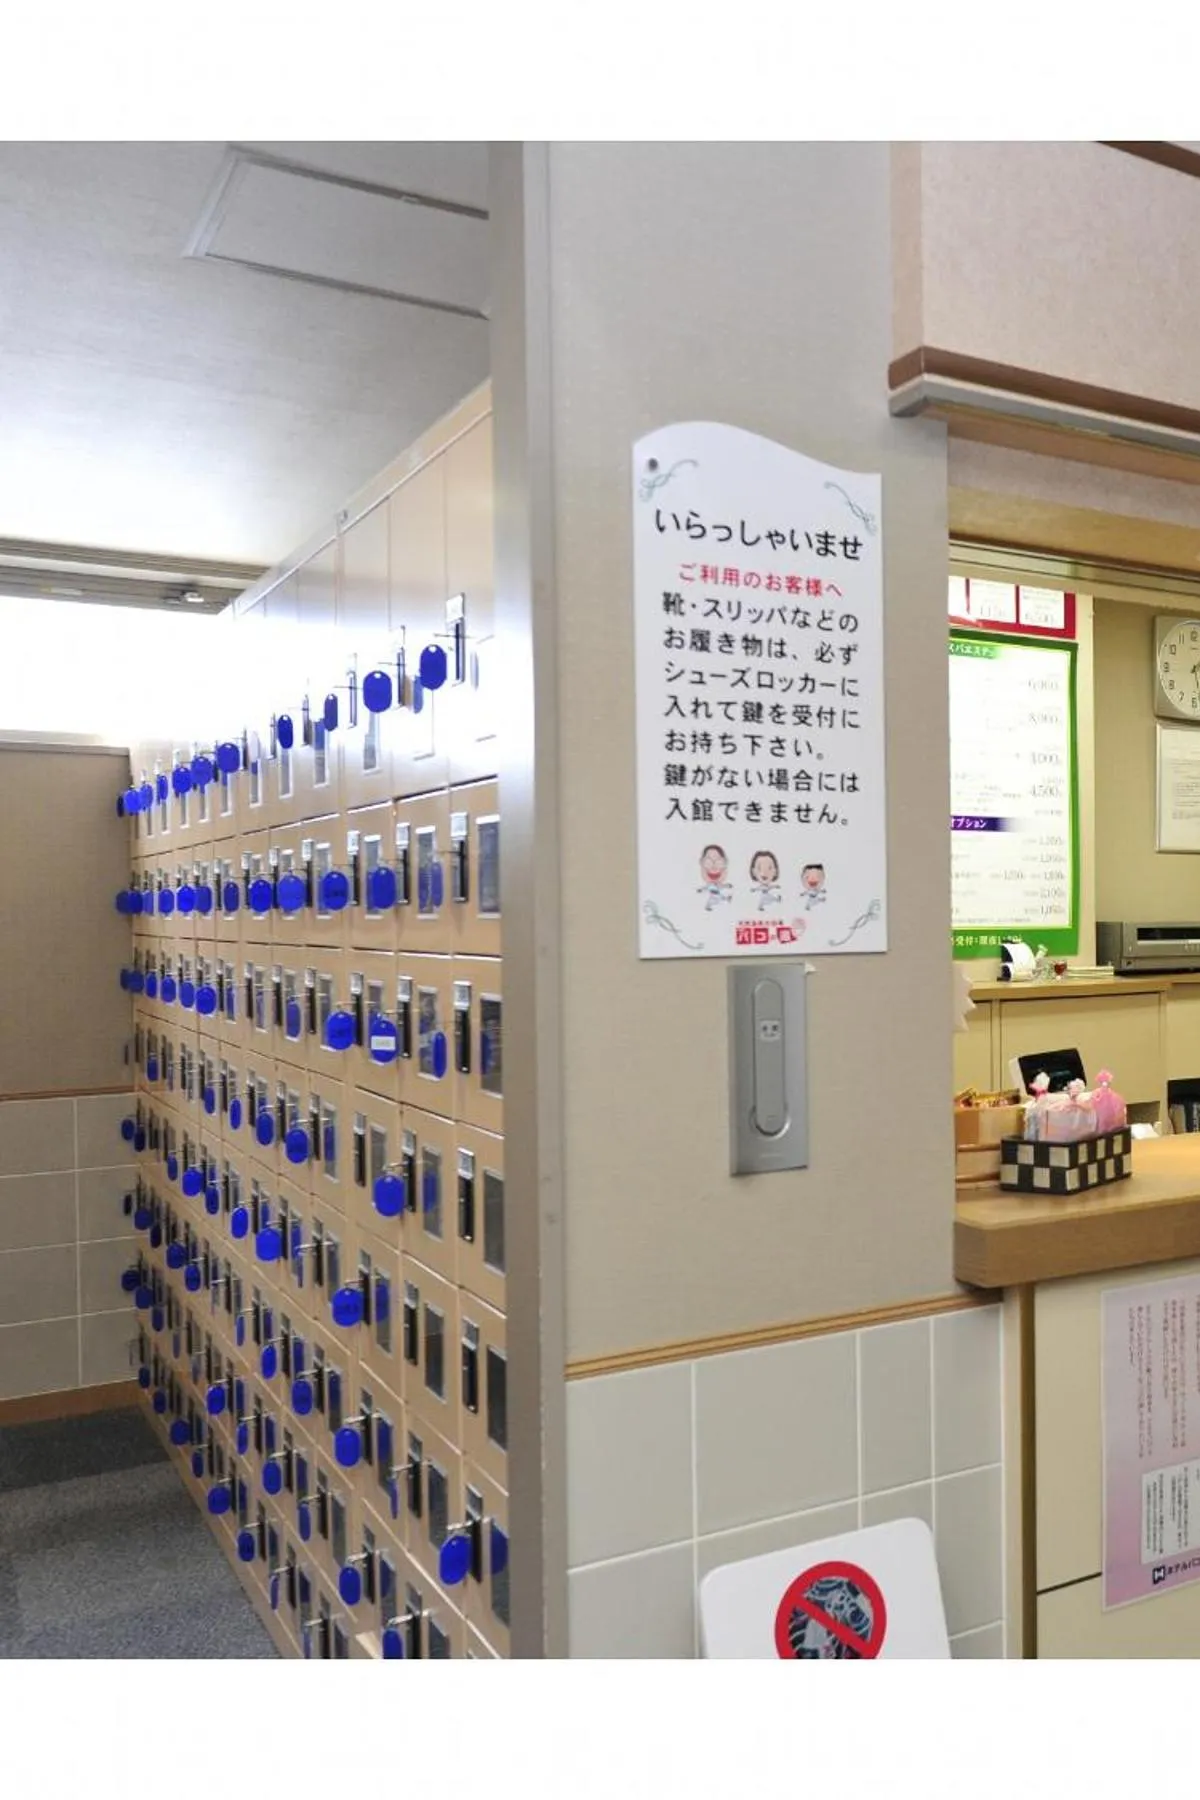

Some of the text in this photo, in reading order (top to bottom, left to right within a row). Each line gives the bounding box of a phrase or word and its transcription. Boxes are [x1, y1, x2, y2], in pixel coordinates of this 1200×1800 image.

[655, 508, 863, 561] いらっしゃいませ
[679, 563, 843, 597] ご利用のお客様へ
[662, 591, 859, 633] 靴・スリッパなどの
[662, 627, 859, 666] お履き物は、必ず
[664, 661, 860, 697] シューズロッカーに
[664, 695, 861, 729] 入れて鍵を受付に
[664, 729, 824, 761] お持ち下さい。
[663, 763, 861, 793] 鍵がない場合には
[665, 798, 848, 826] 入館できません。
